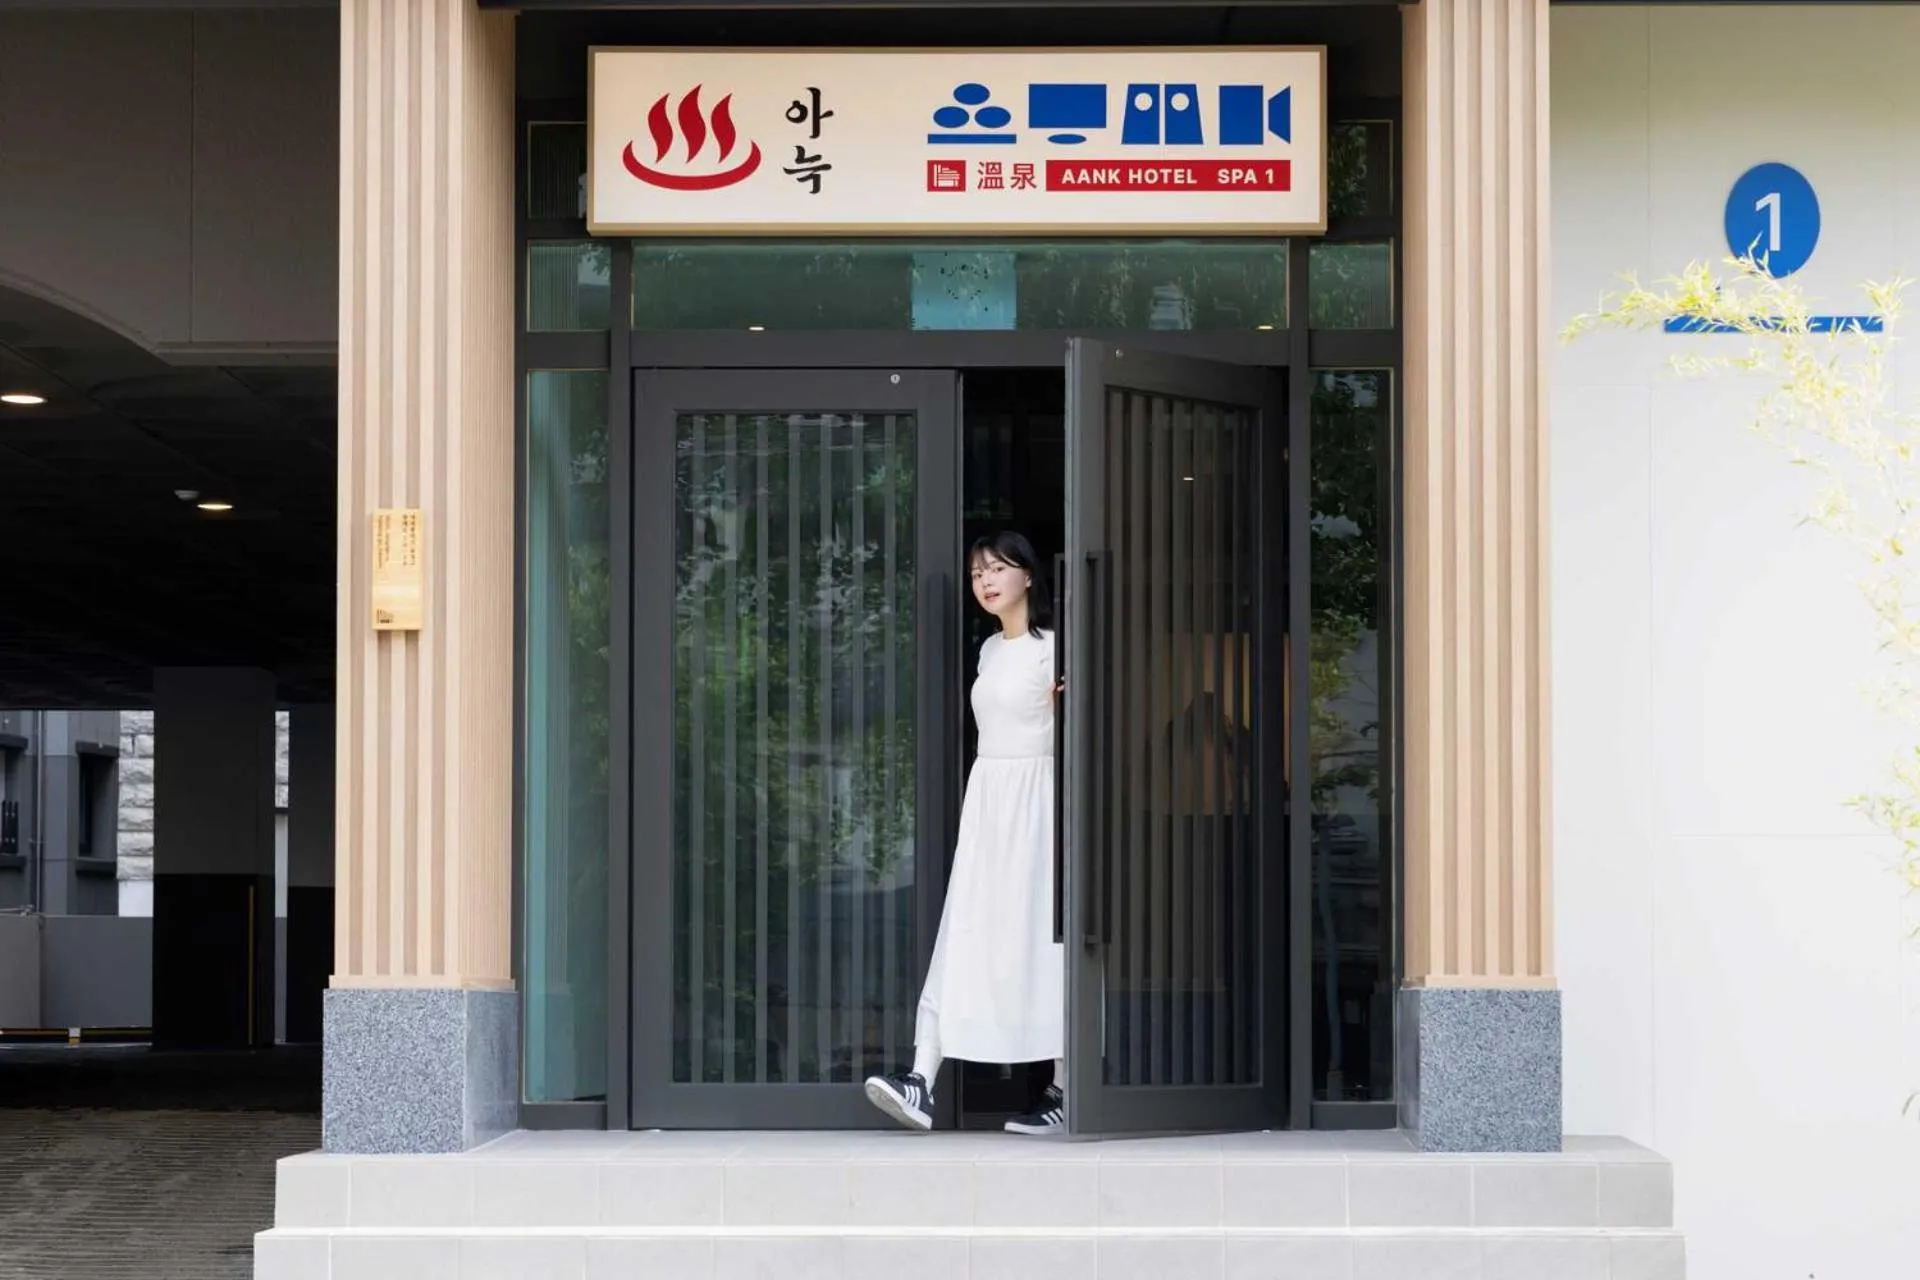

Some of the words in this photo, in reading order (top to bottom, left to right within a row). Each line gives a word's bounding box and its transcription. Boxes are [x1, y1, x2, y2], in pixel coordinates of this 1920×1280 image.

[783, 86, 834, 195] 아늑
[977, 161, 1037, 190] 溫泉
[1061, 168, 1121, 184] AANK
[1128, 168, 1197, 184] HOTEL
[1217, 168, 1257, 184] SPA
[1264, 168, 1274, 184] 1
[1755, 192, 1781, 251] 1
